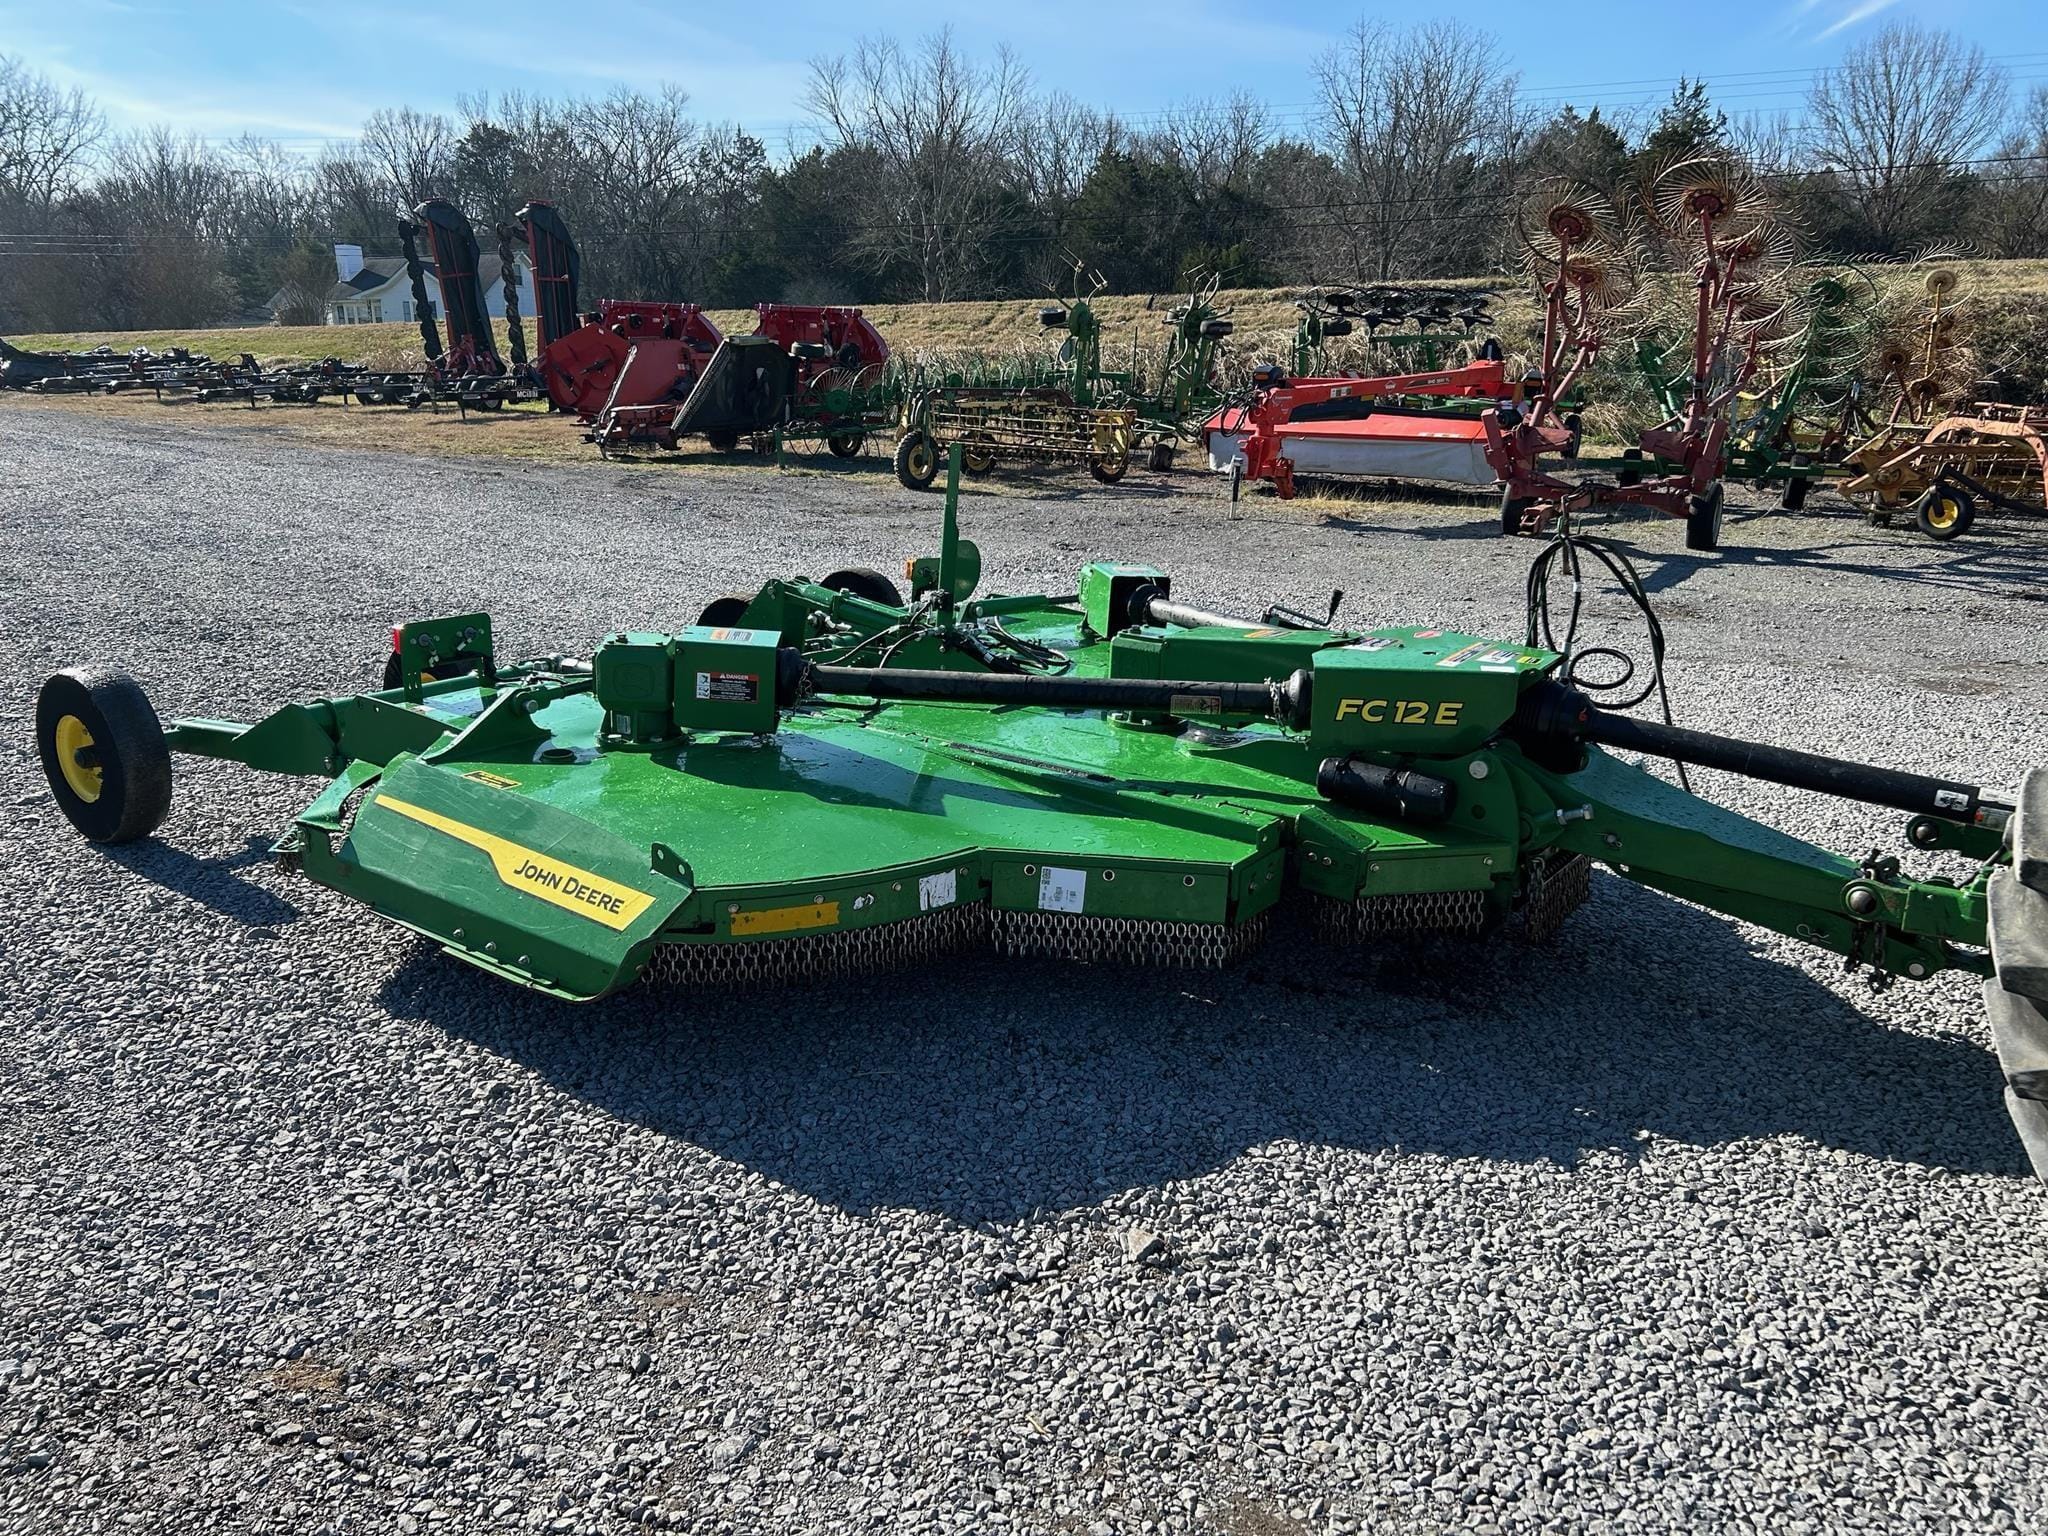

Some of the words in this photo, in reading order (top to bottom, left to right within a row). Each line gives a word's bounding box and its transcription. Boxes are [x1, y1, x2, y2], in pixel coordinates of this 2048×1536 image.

[1335, 698, 1388, 722] FC
[1393, 701, 1430, 724] 12
[1433, 702, 1463, 725] E
[513, 859, 563, 890] JOHN
[562, 876, 625, 914] DEERE
